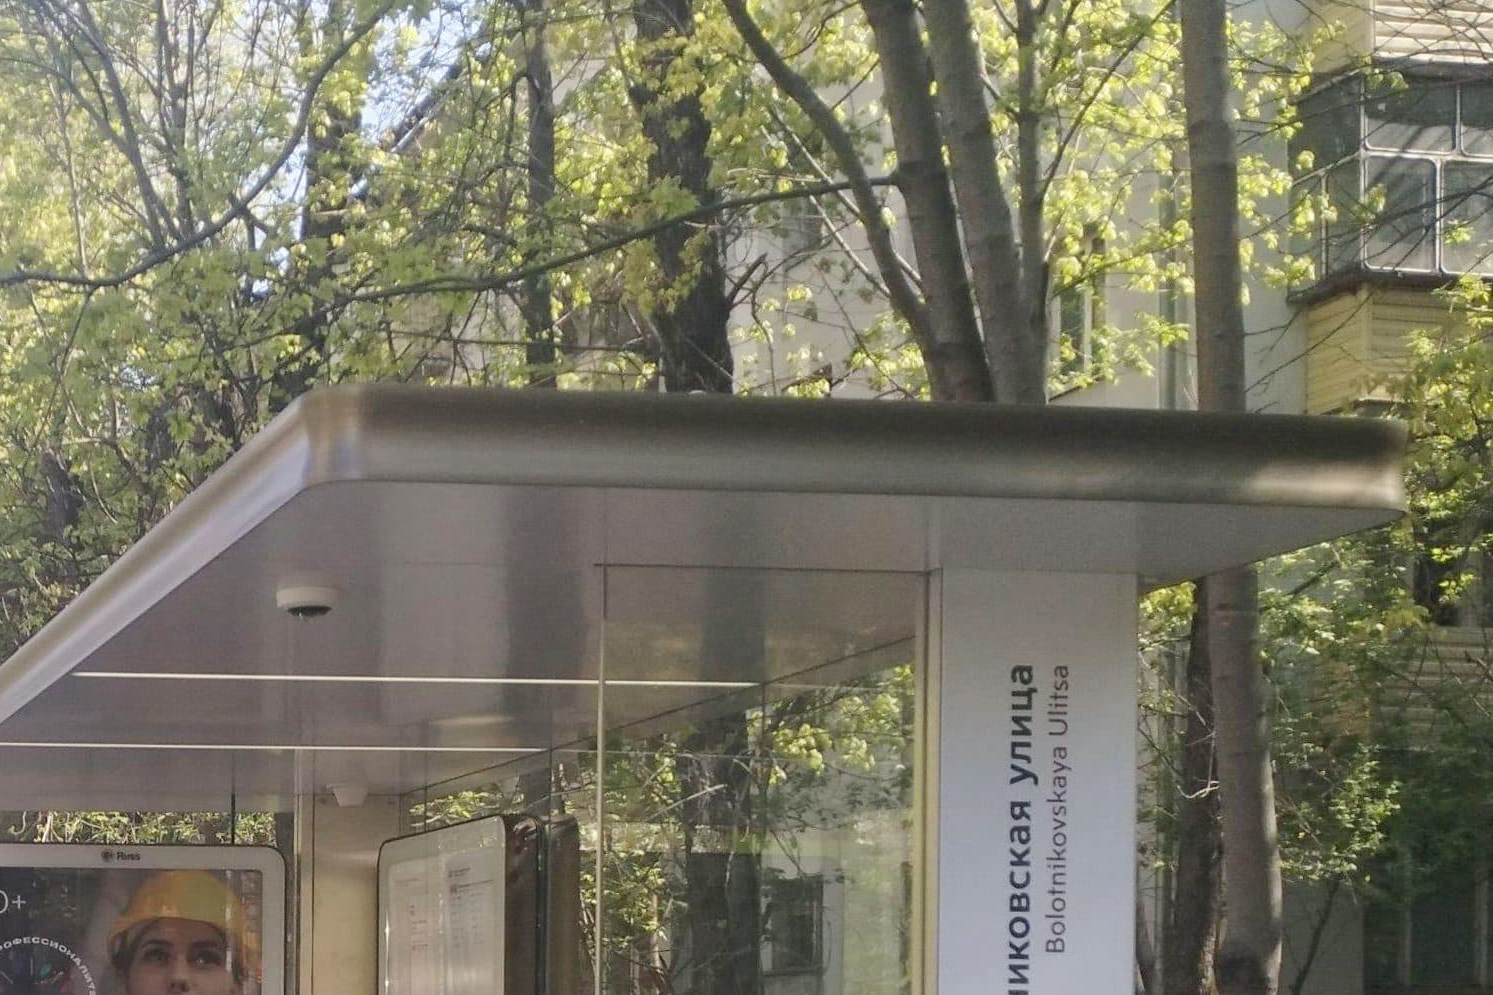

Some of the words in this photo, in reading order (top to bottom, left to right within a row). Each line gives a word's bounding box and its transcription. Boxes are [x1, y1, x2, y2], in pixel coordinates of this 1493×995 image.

[1009, 665, 1039, 786] улица
[1047, 665, 1069, 735] Ulitsa
[1044, 746, 1072, 953] Bolotnikovskaya
